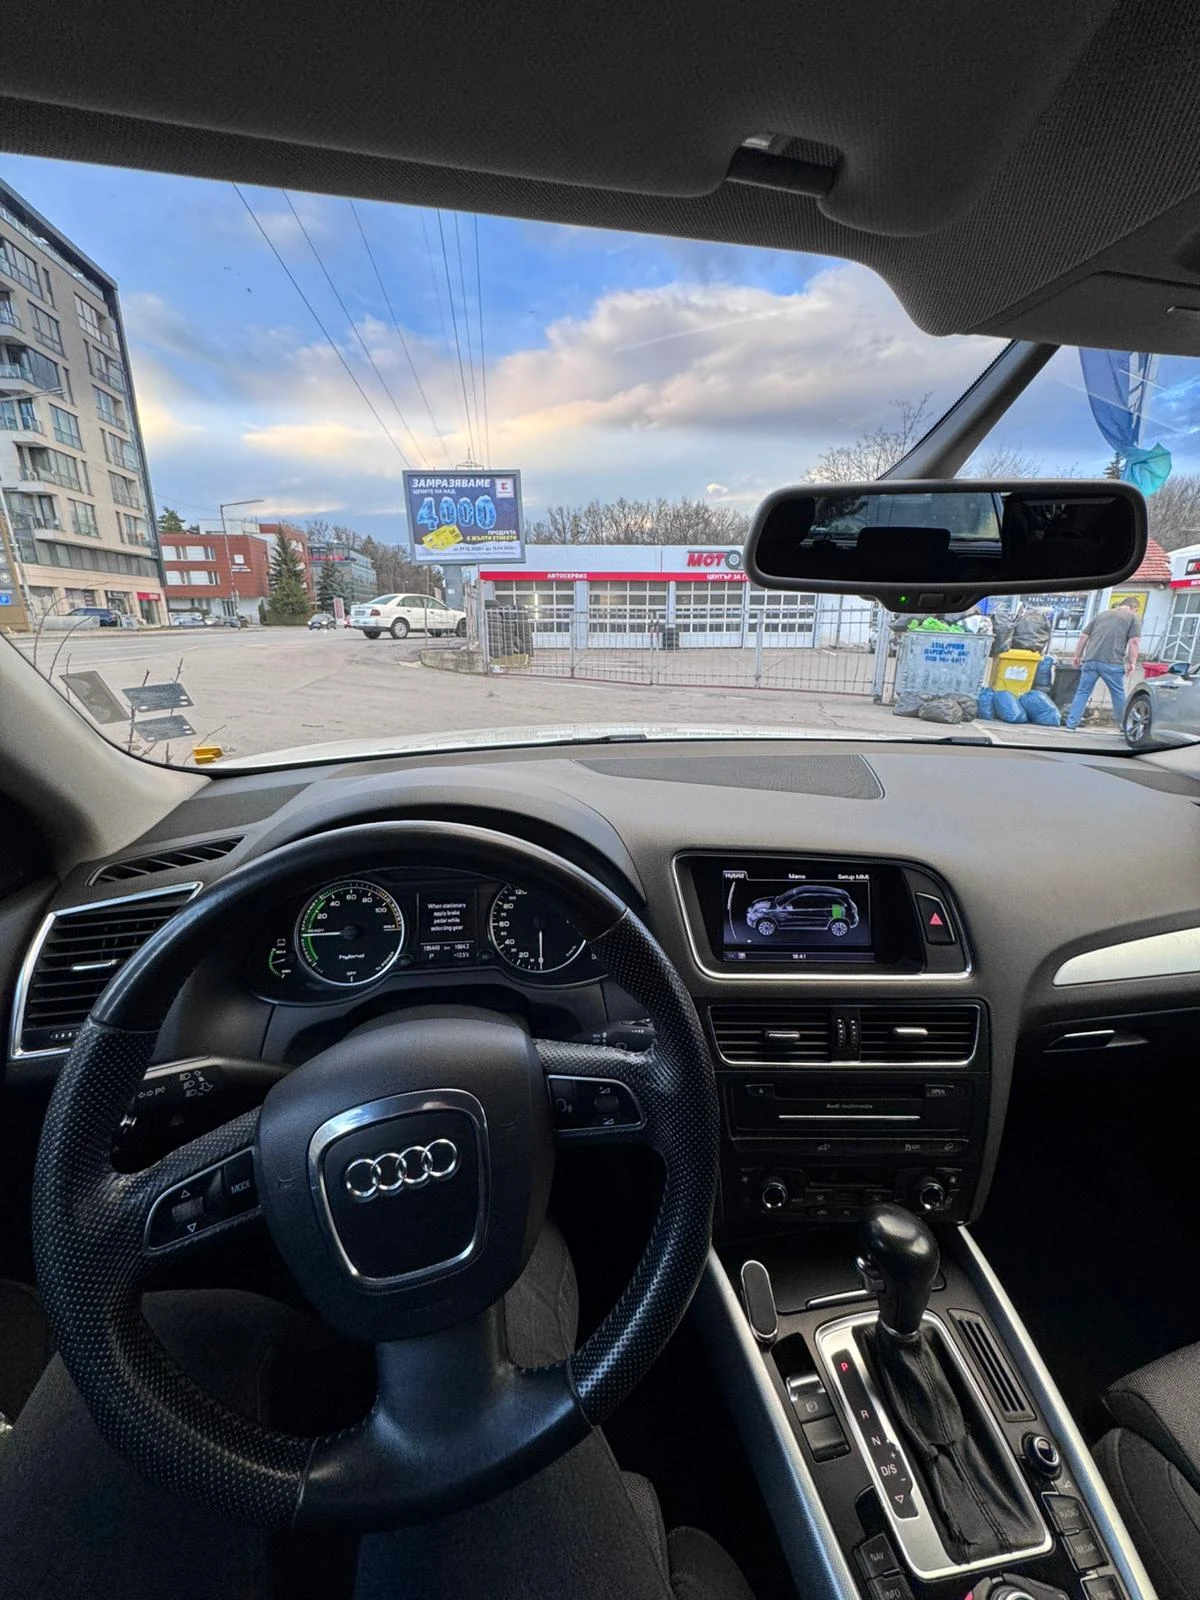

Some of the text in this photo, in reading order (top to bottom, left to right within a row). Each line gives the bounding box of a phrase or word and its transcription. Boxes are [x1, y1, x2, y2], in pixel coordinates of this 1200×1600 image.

[412, 478, 491, 488] ЗАМРАЗЯВАМЕ
[416, 495, 497, 530] 4000
[231, 1179, 252, 1194] MODE
[840, 1362, 849, 1373] P
[860, 1409, 870, 1420] R
[871, 1436, 882, 1446] N
[880, 1463, 898, 1477] D/S
[1059, 1509, 1079, 1518] RADIO
[1074, 1544, 1096, 1554] MEDIA
[869, 1552, 884, 1562] NAV
